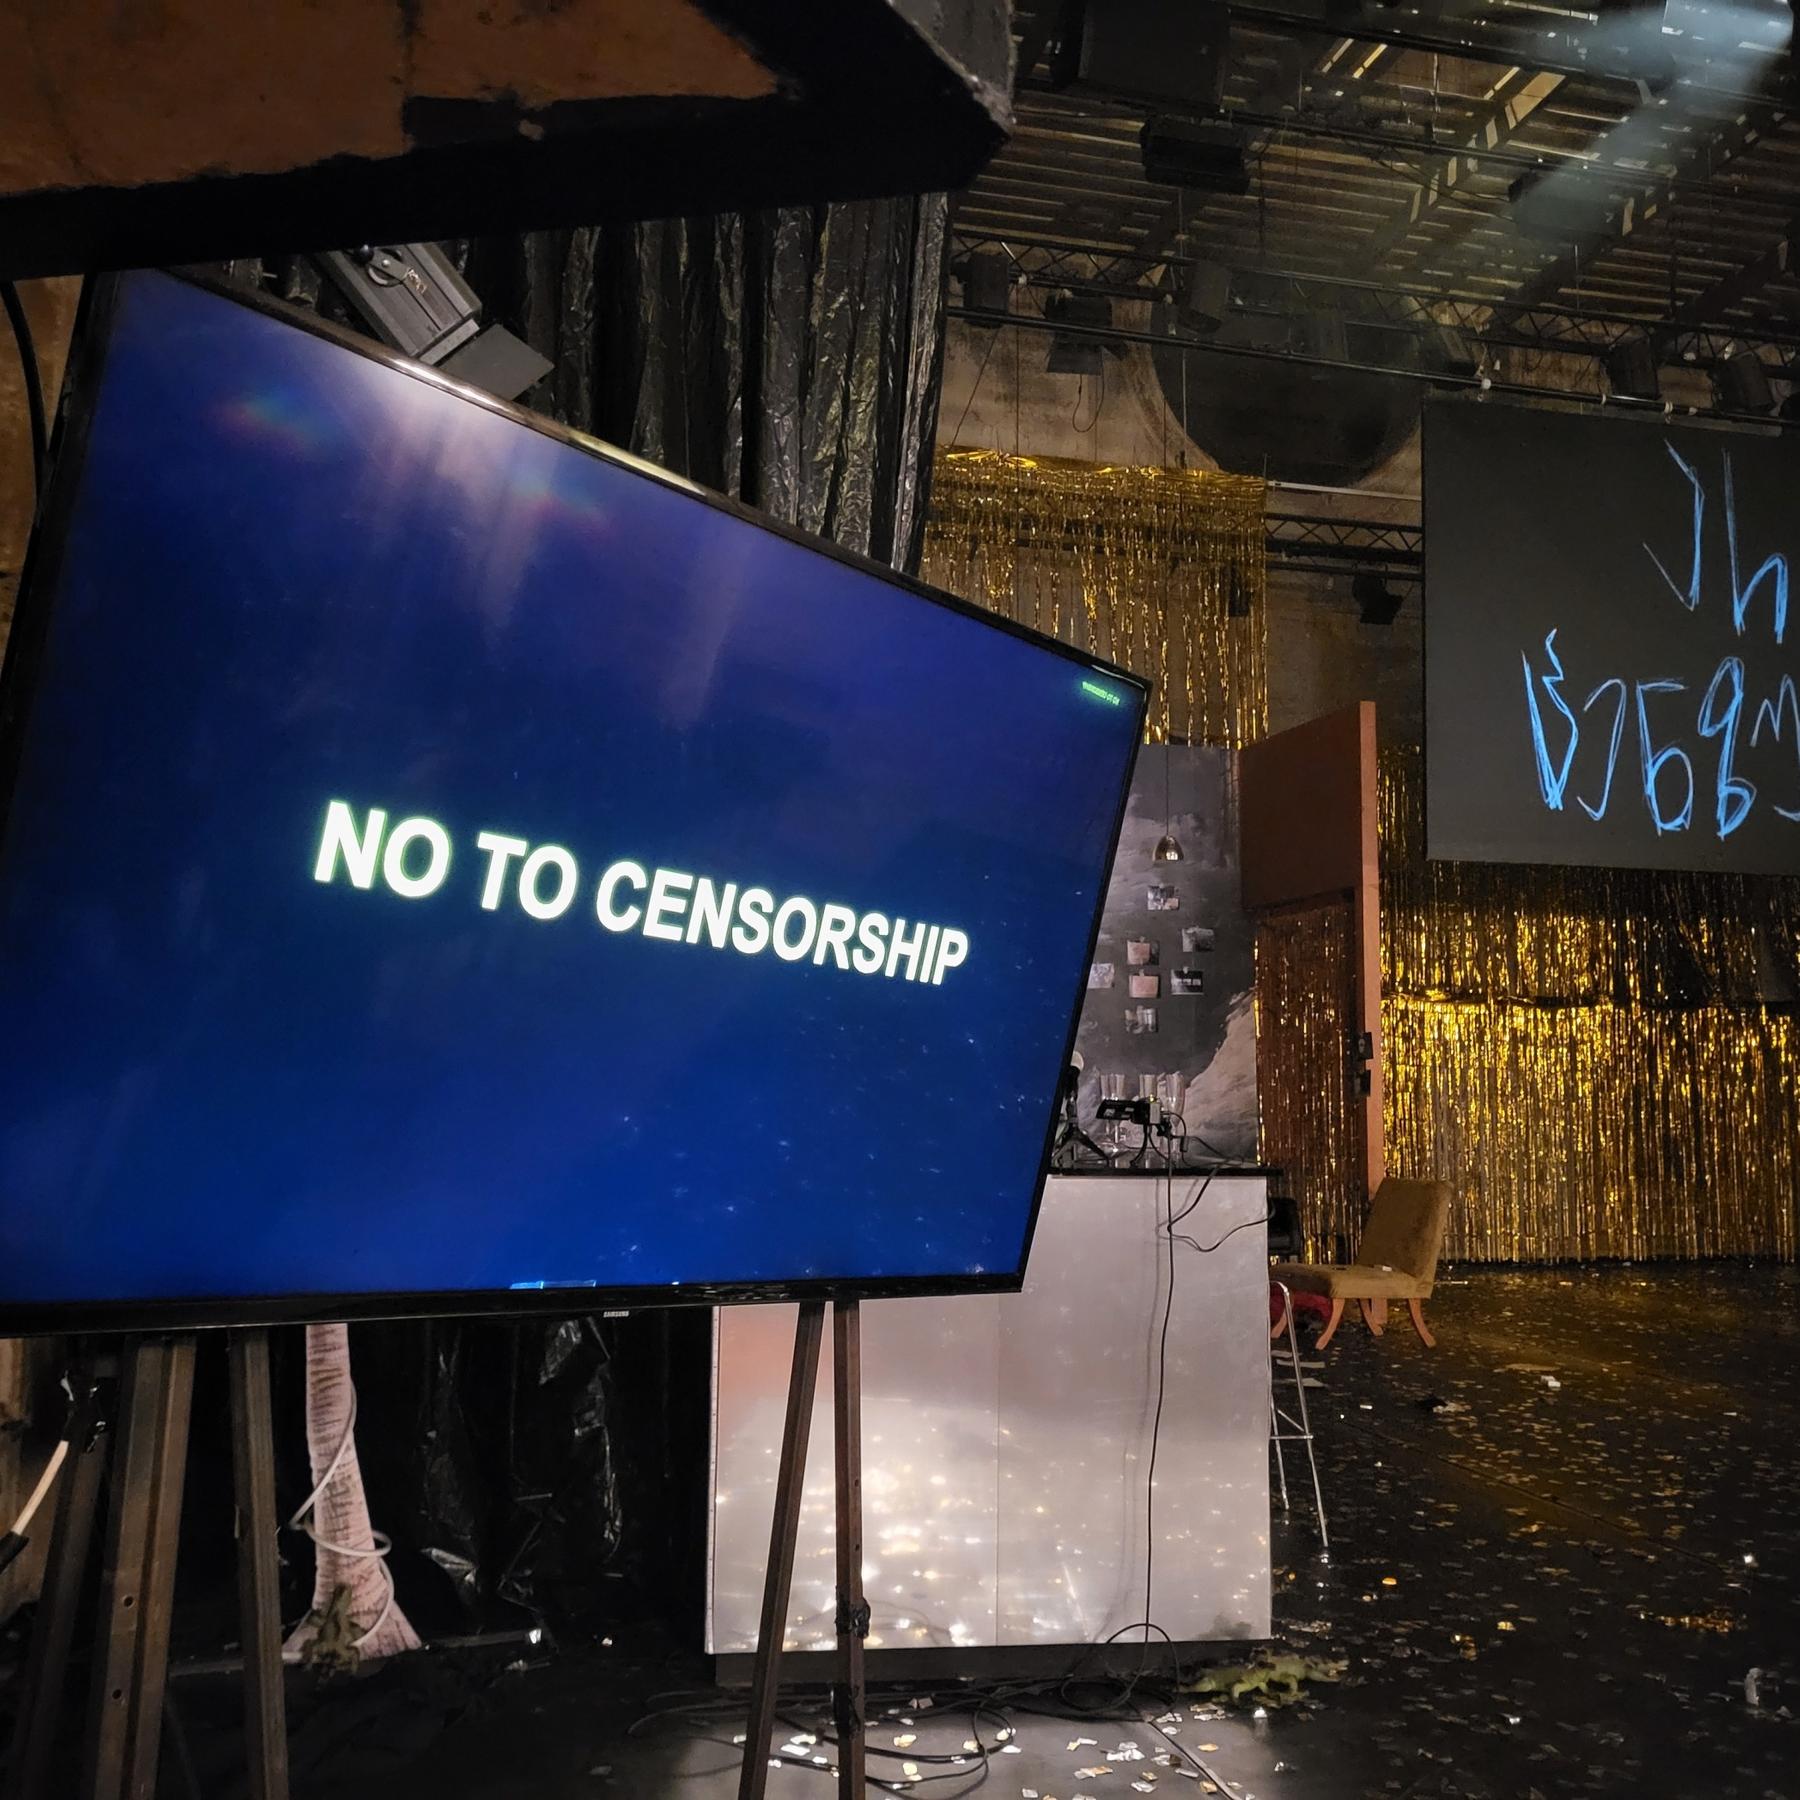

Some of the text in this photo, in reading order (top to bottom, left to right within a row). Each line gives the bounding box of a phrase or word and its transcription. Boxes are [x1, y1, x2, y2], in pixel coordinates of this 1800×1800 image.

[313, 799, 970, 986] NO TO CENSORSHIP
